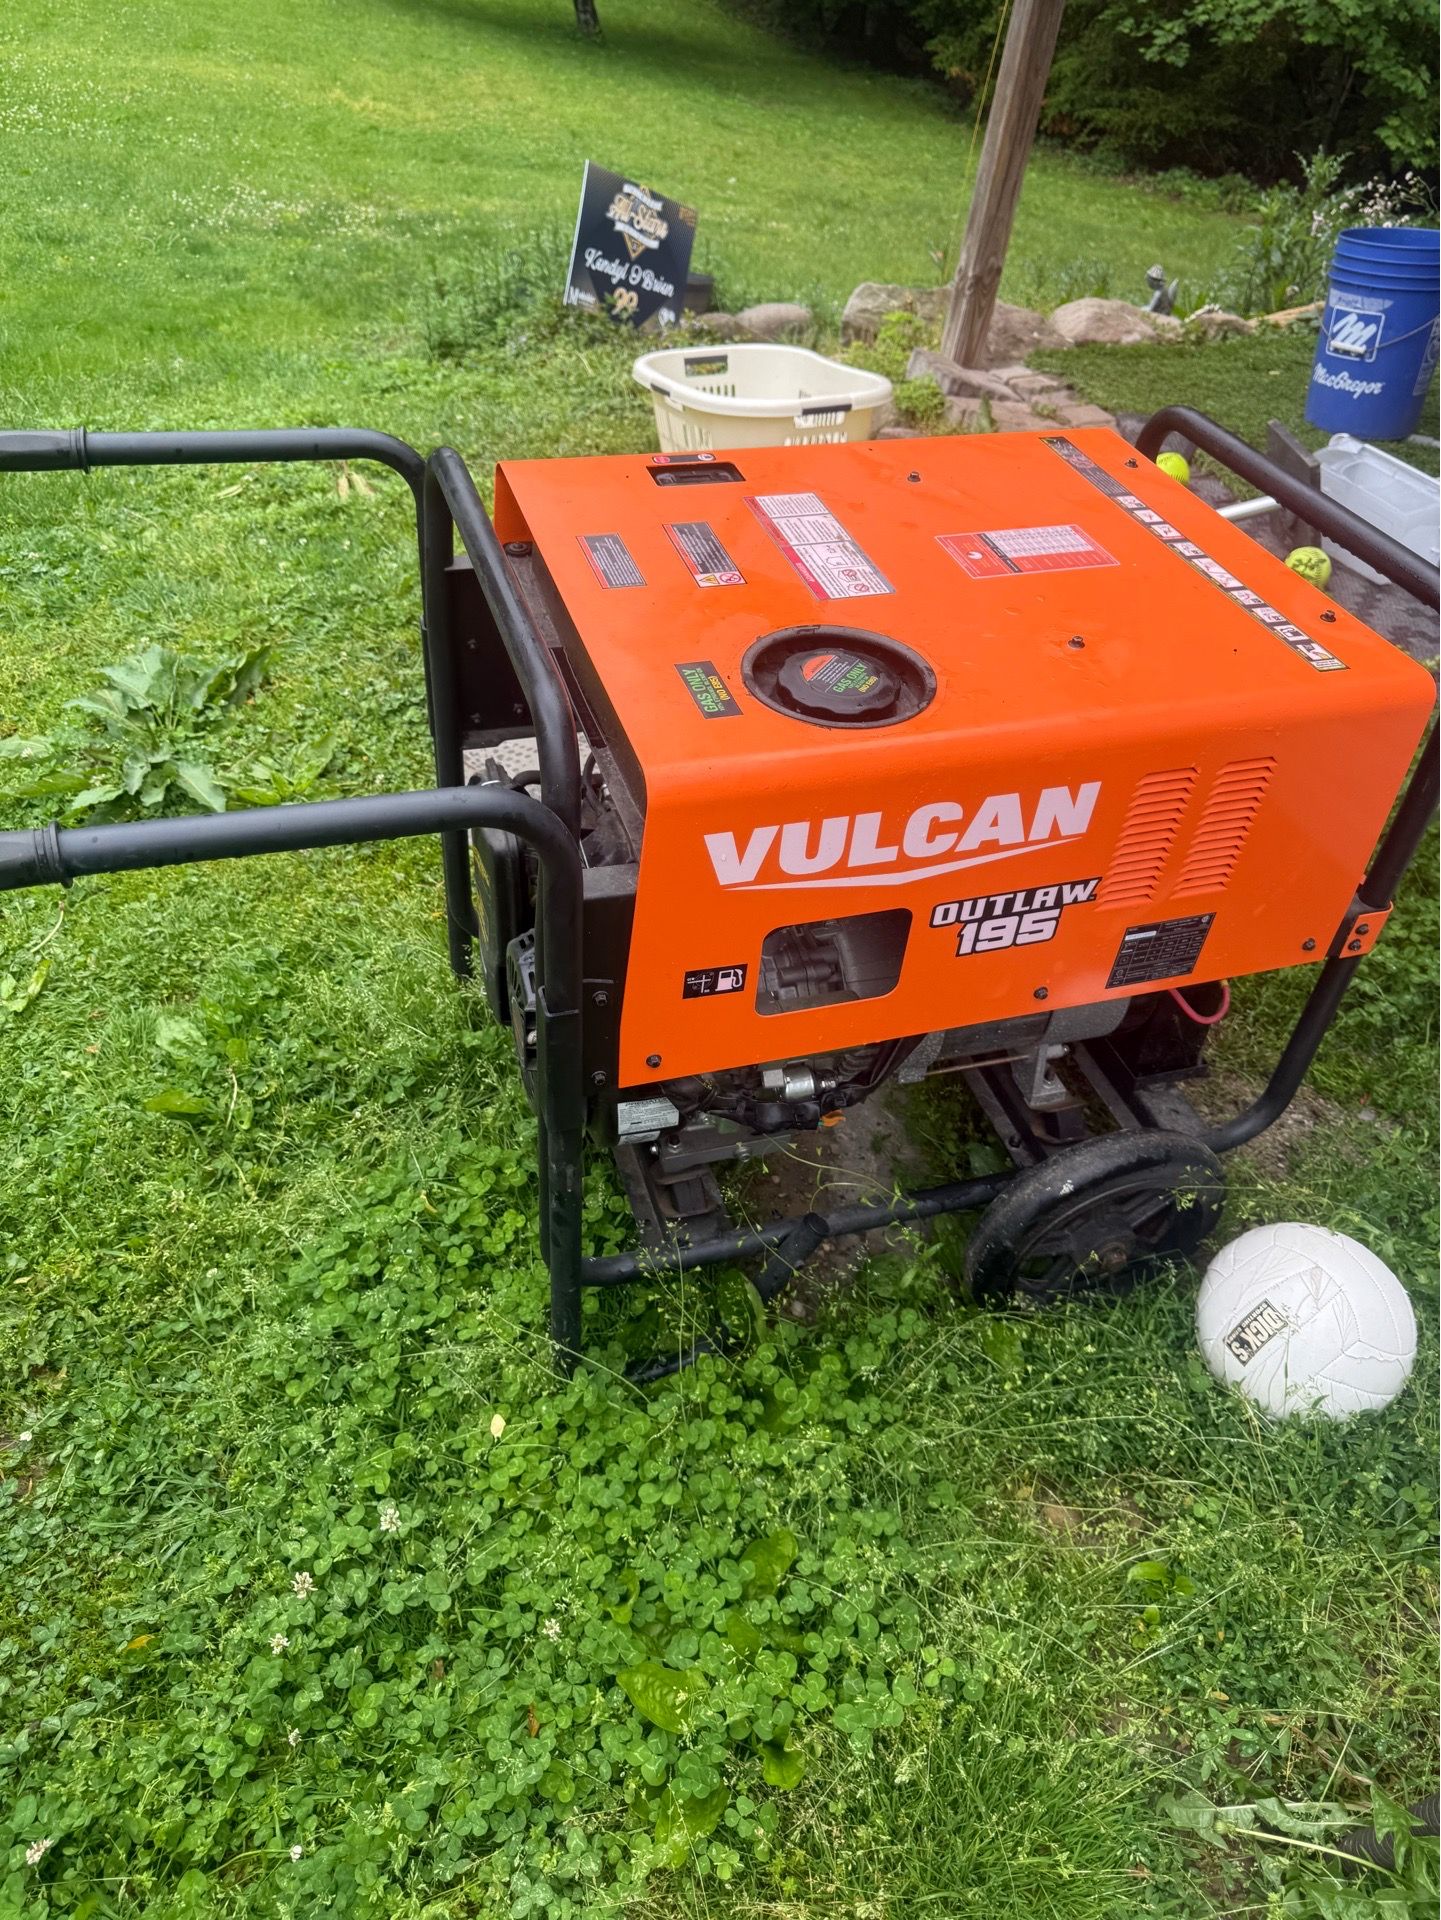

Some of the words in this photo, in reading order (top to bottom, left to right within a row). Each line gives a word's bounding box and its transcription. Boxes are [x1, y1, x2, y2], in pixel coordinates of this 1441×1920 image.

[1313, 362, 1383, 399] MacGregor
[682, 669, 706, 692] ONLY
[833, 679, 852, 693] GAS
[846, 662, 867, 680] ONLY
[697, 693, 719, 713] GAS
[704, 781, 1102, 886] VULCAN
[931, 878, 1100, 927] OUTLAW
[957, 908, 1061, 956] 195
[1230, 1306, 1287, 1362] DICK'S
